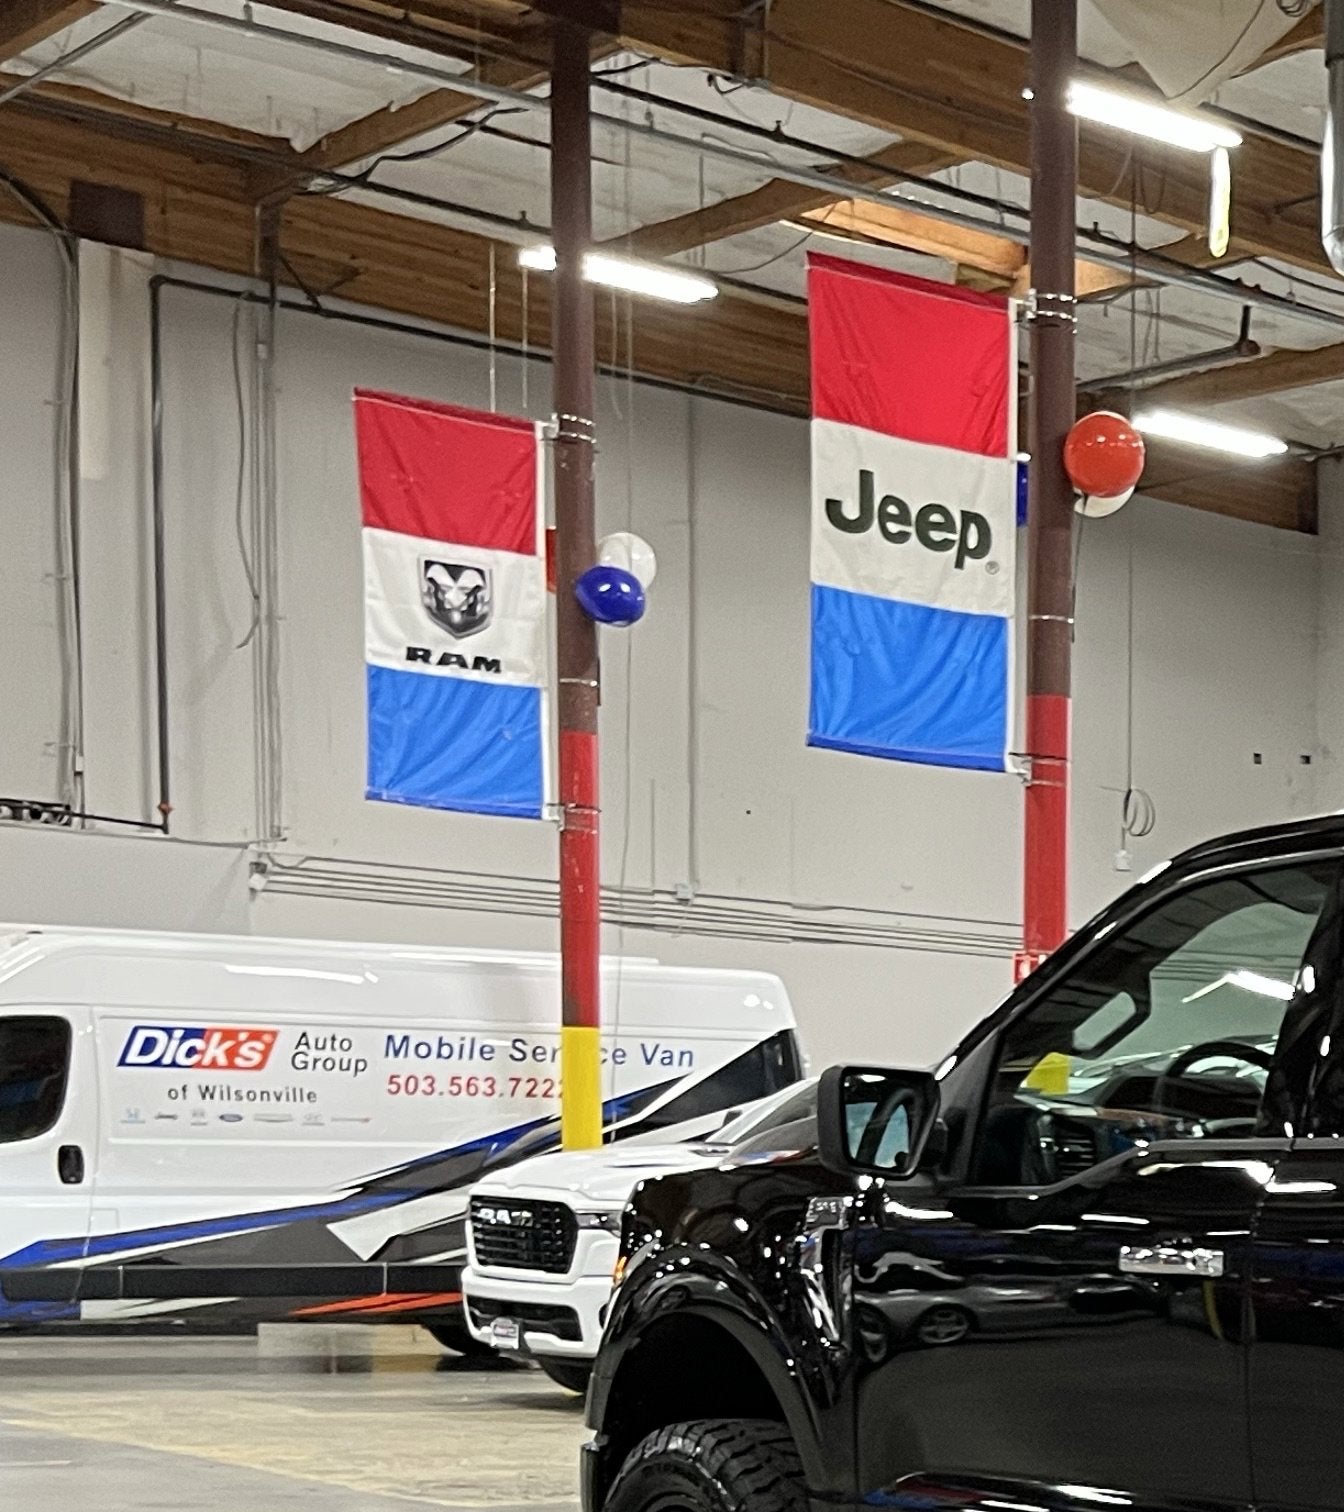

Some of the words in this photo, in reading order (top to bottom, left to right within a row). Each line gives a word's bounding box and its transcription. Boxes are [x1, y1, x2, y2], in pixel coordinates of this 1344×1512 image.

[825, 469, 993, 570] Jeep
[405, 646, 502, 674] RAM
[125, 1028, 267, 1067] Dick's
[294, 1031, 353, 1052] Auto
[383, 1034, 496, 1062] Mobile
[508, 1037, 628, 1066] Serce
[640, 1042, 695, 1068] Van
[291, 1051, 369, 1077] Group
[167, 1084, 189, 1101] of
[199, 1084, 318, 1104] Wilsonville
[386, 1074, 564, 1099] 503.563.722
